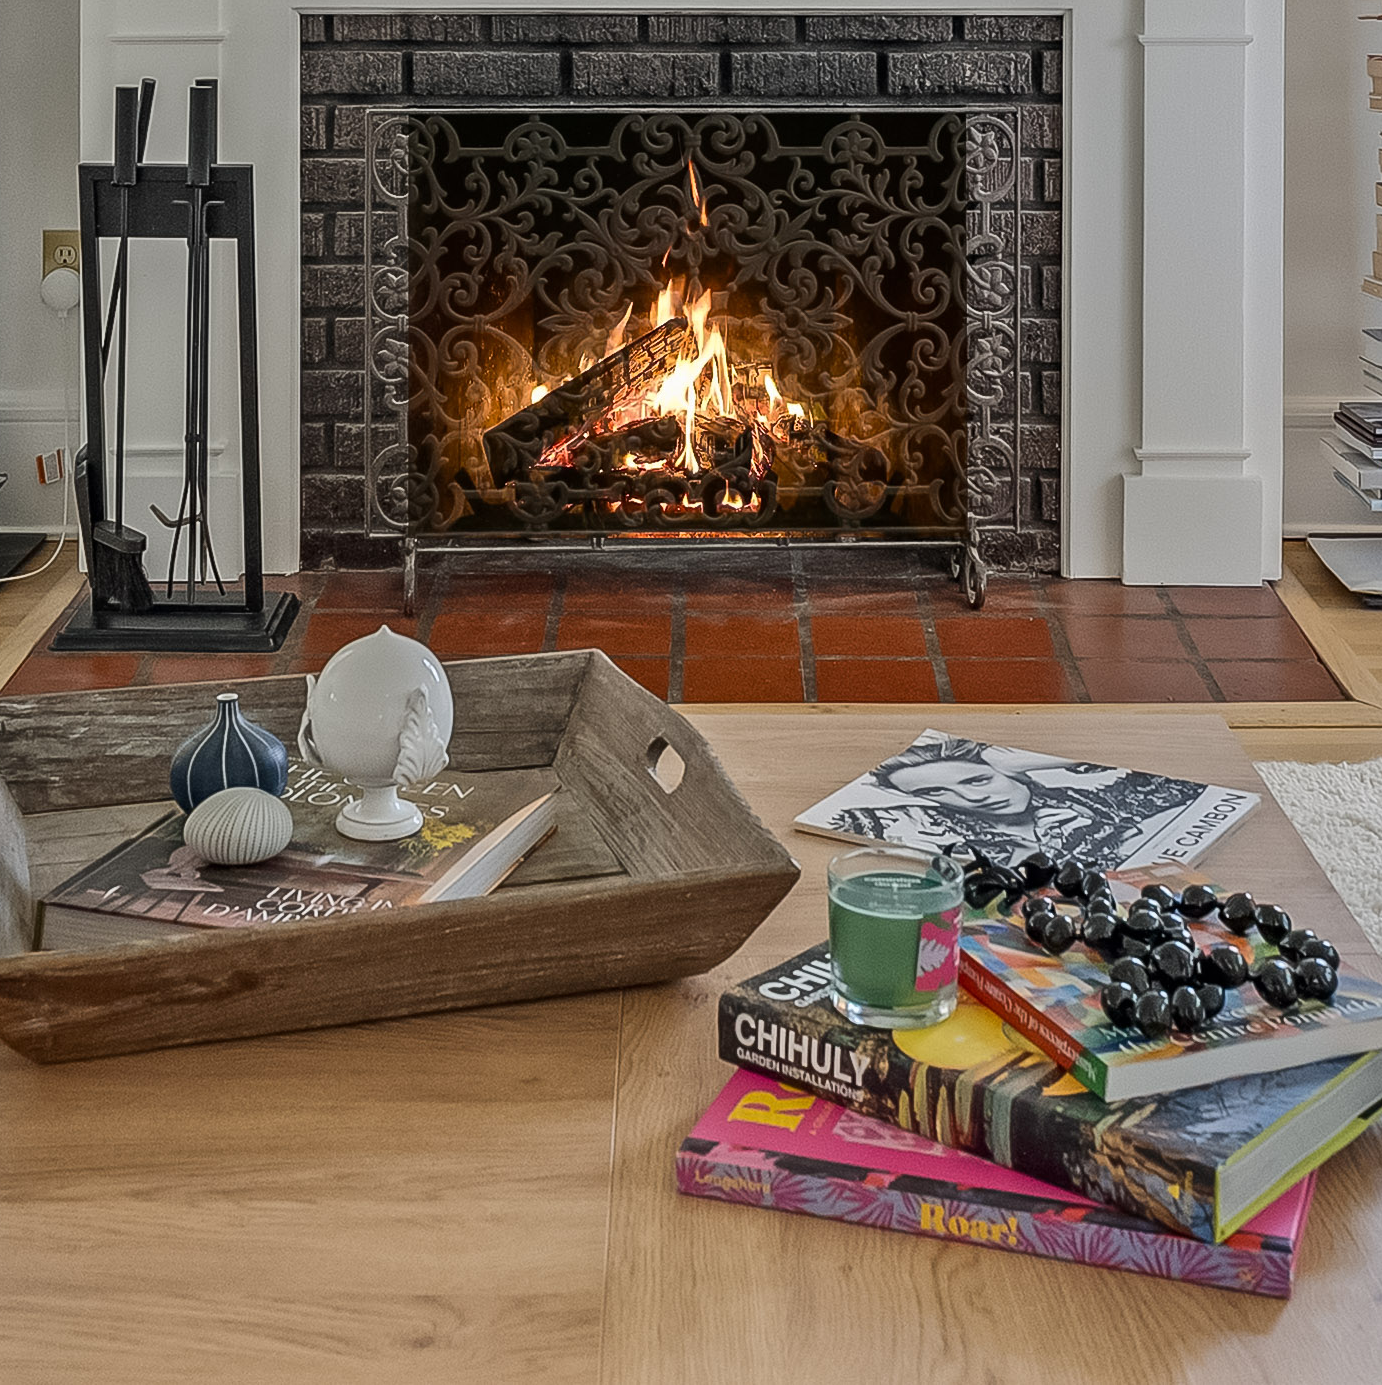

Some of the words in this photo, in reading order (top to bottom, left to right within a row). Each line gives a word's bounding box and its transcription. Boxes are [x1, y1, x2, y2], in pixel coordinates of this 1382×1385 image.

[1175, 792, 1248, 847] CAMBON
[734, 1012, 871, 1087] CHIHULY
[736, 1046, 780, 1074] GARDEN
[782, 1065, 864, 1102] INSTALLATIONS
[919, 1202, 1017, 1246] Roar!
